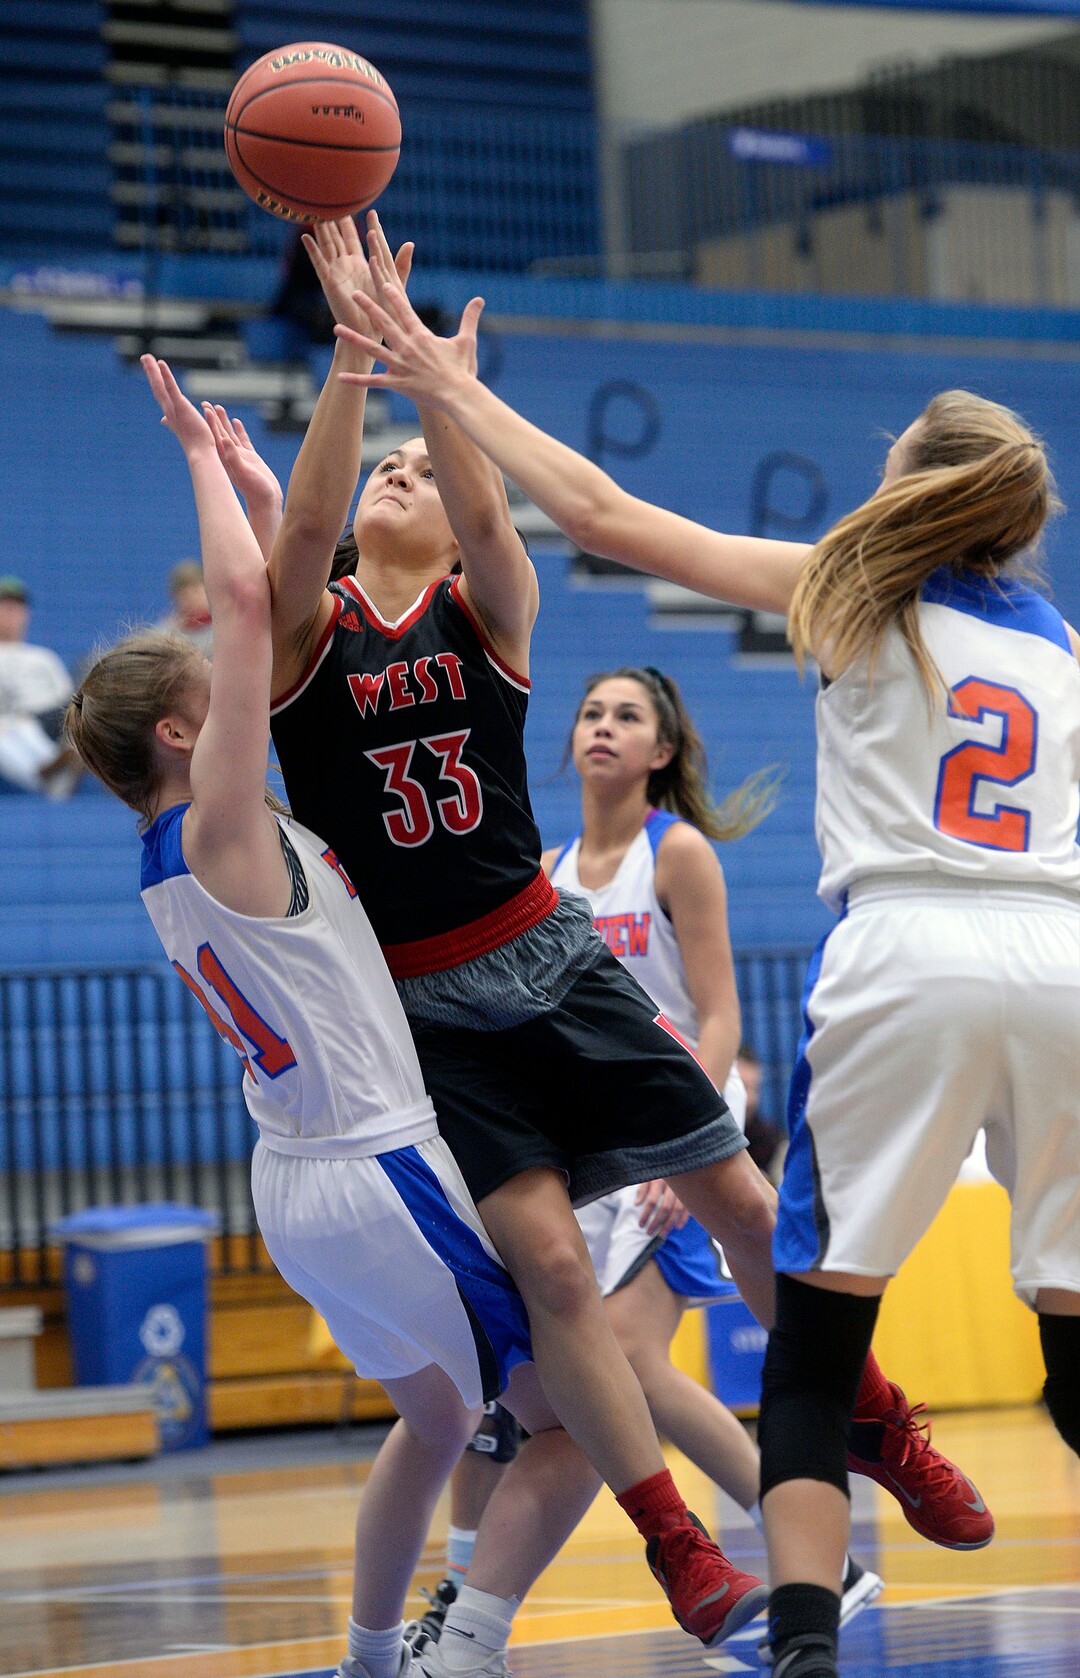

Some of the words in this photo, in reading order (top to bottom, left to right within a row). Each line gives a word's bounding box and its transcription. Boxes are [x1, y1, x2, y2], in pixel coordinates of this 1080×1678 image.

[346, 652, 467, 720] WEST
[362, 727, 484, 849] 33
[933, 674, 1039, 852] 2
